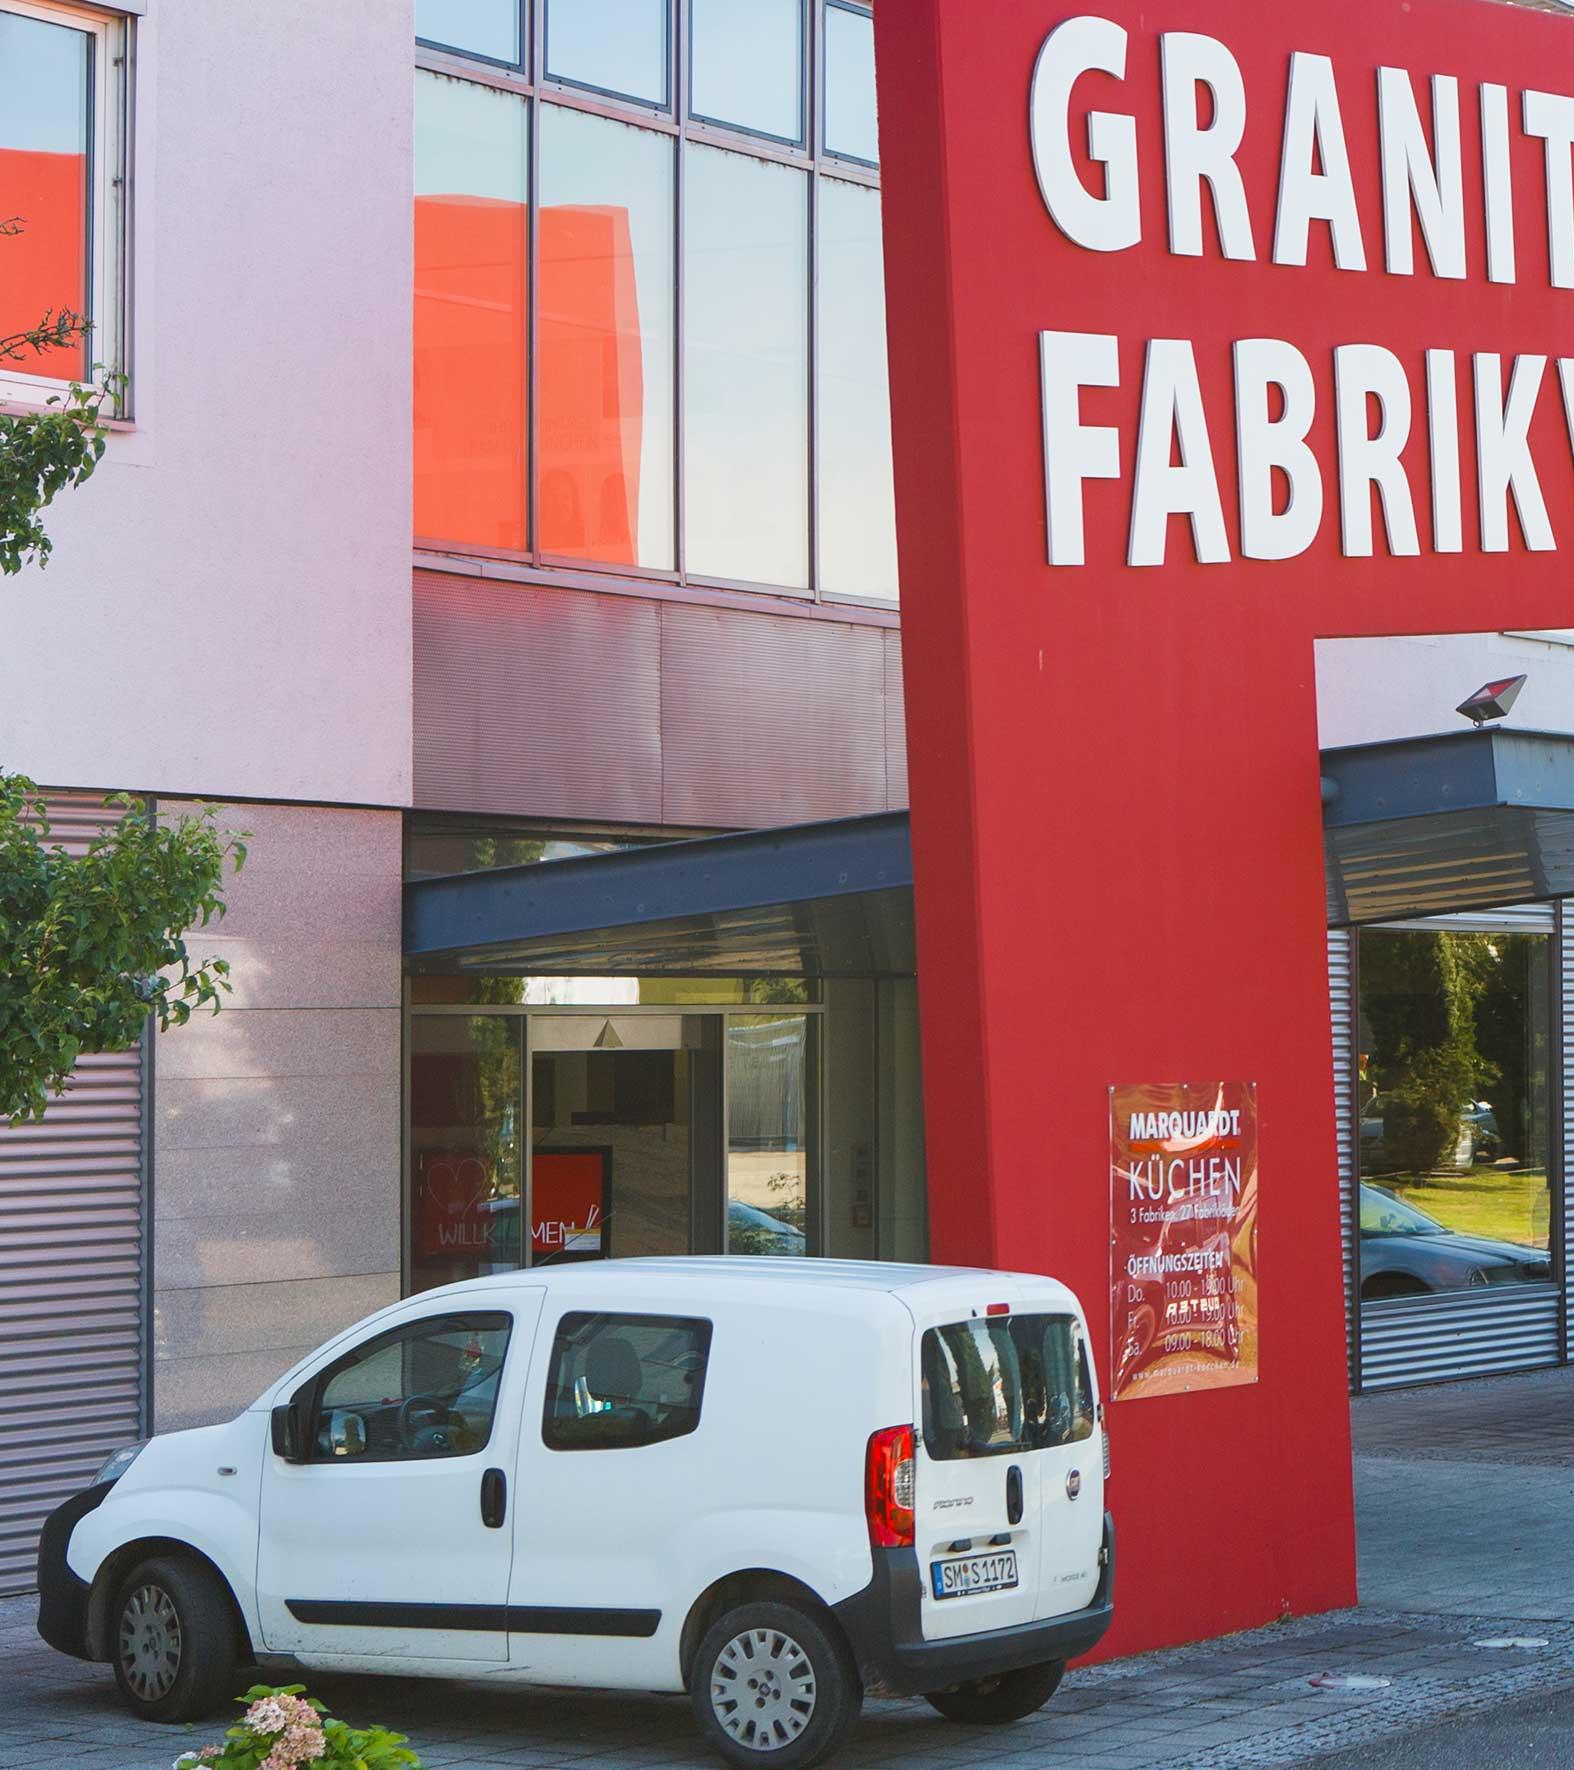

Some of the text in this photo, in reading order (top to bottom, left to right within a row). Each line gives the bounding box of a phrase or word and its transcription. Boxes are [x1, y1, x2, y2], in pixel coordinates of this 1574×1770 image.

[1129, 1154, 1241, 1201] KÜCHEN
[1130, 1207, 1137, 1224] 3
[1127, 1251, 1224, 1275] ÖFFNUNGSZEITEN
[1127, 1284, 1145, 1303] Do.
[1166, 1280, 1191, 1298] 10.00
[1228, 1276, 1245, 1294] Uhr
[1228, 1301, 1245, 1320] Uhr
[1165, 1333, 1191, 1352] 09.00
[1201, 1329, 1225, 1348] 18.00
[943, 1564, 963, 1588] SM
